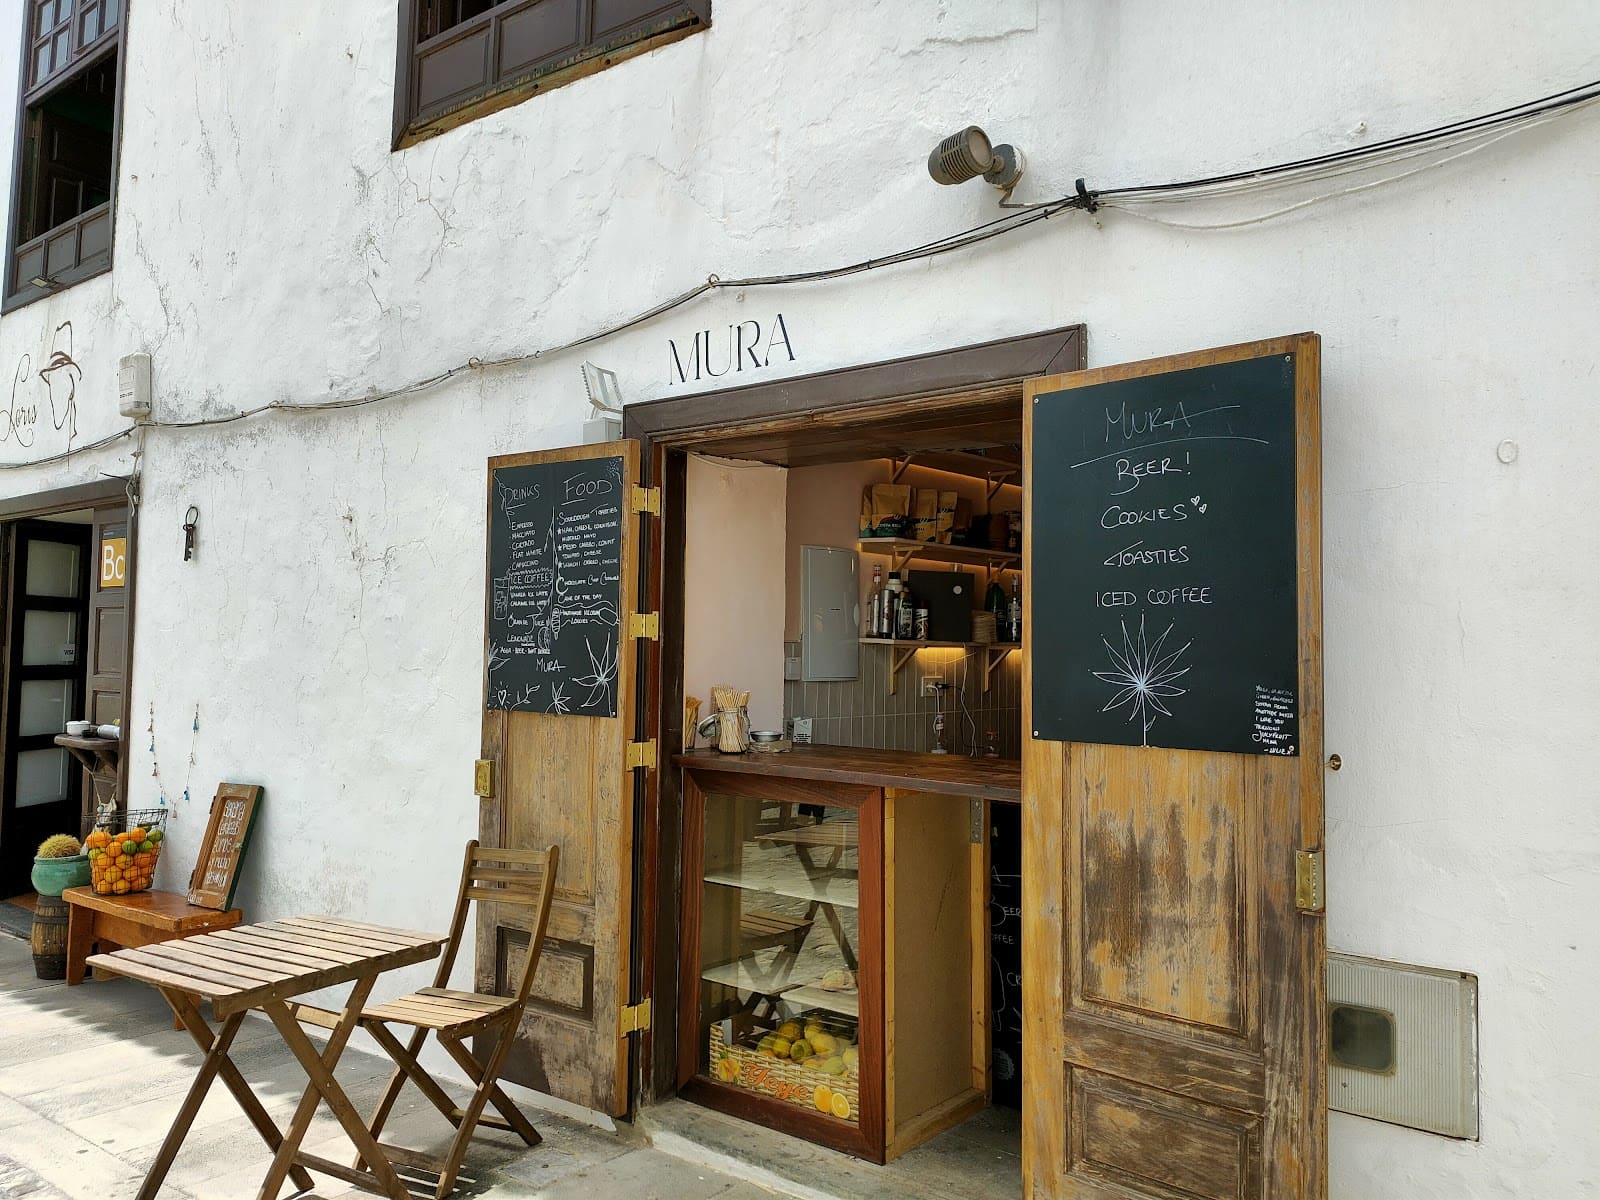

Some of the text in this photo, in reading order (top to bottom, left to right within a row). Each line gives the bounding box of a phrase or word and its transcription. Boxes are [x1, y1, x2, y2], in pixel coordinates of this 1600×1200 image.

[668, 313, 796, 385] MURA
[1105, 401, 1240, 443] MURA
[504, 483, 540, 506] DRINKS
[563, 472, 613, 500] FOOD
[1101, 504, 1188, 529] COOKIES
[103, 545, 124, 580] Bc
[1103, 541, 1190, 568] TOASTIES
[1096, 587, 1213, 607] ICED COFFEE
[536, 657, 566, 672] MURA
